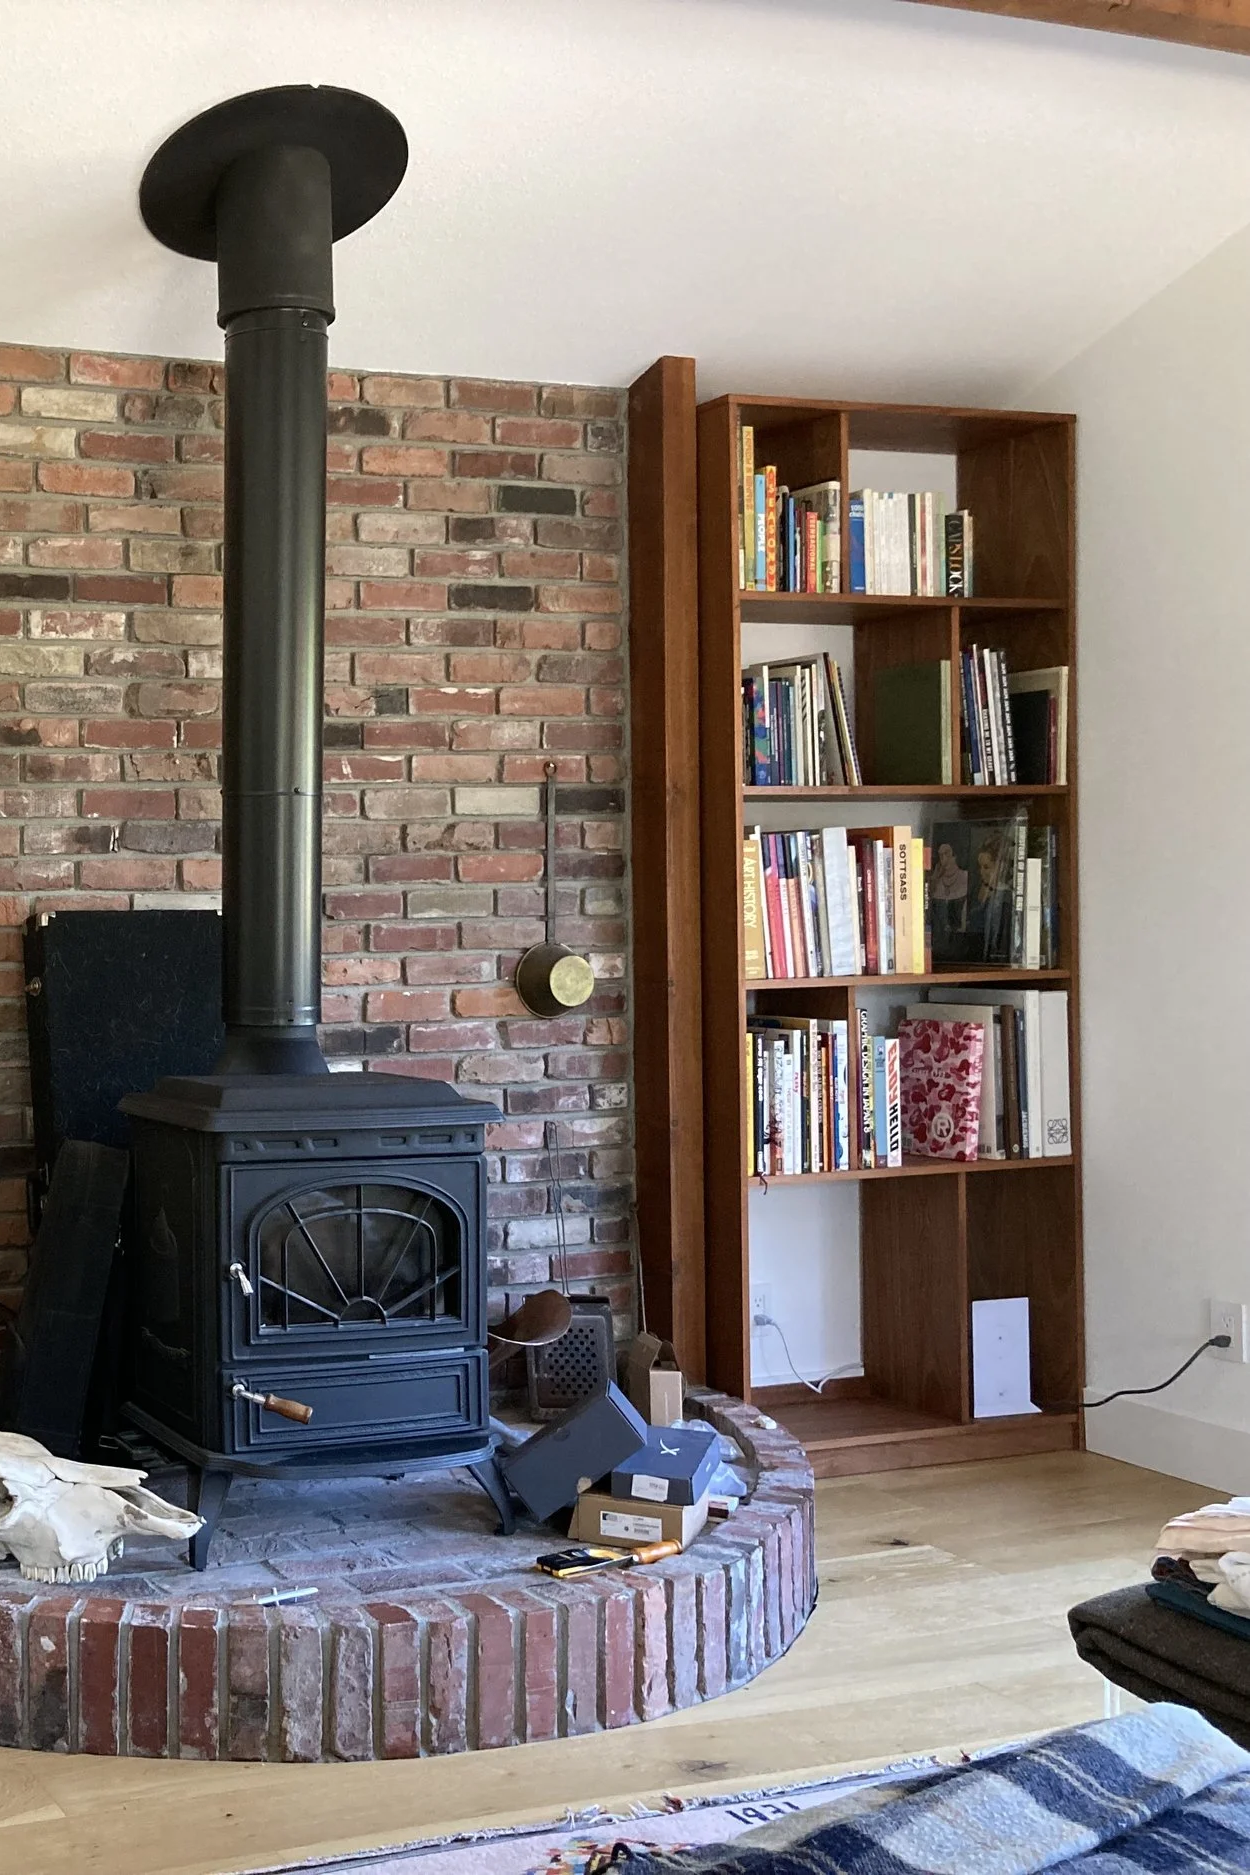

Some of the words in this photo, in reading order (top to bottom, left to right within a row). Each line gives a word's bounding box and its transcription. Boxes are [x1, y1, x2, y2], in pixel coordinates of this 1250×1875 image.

[758, 513, 766, 552] PEOPLE
[743, 857, 757, 879] ART
[899, 843, 907, 901] SOTTSASS
[743, 880, 757, 928] HISTORY
[860, 1010, 869, 1050] GRAPHIC
[861, 1051, 870, 1084] DESIGN
[862, 1086, 870, 1097] IN
[862, 1097, 870, 1125] JAPAN
[888, 1103, 899, 1152] HELLO
